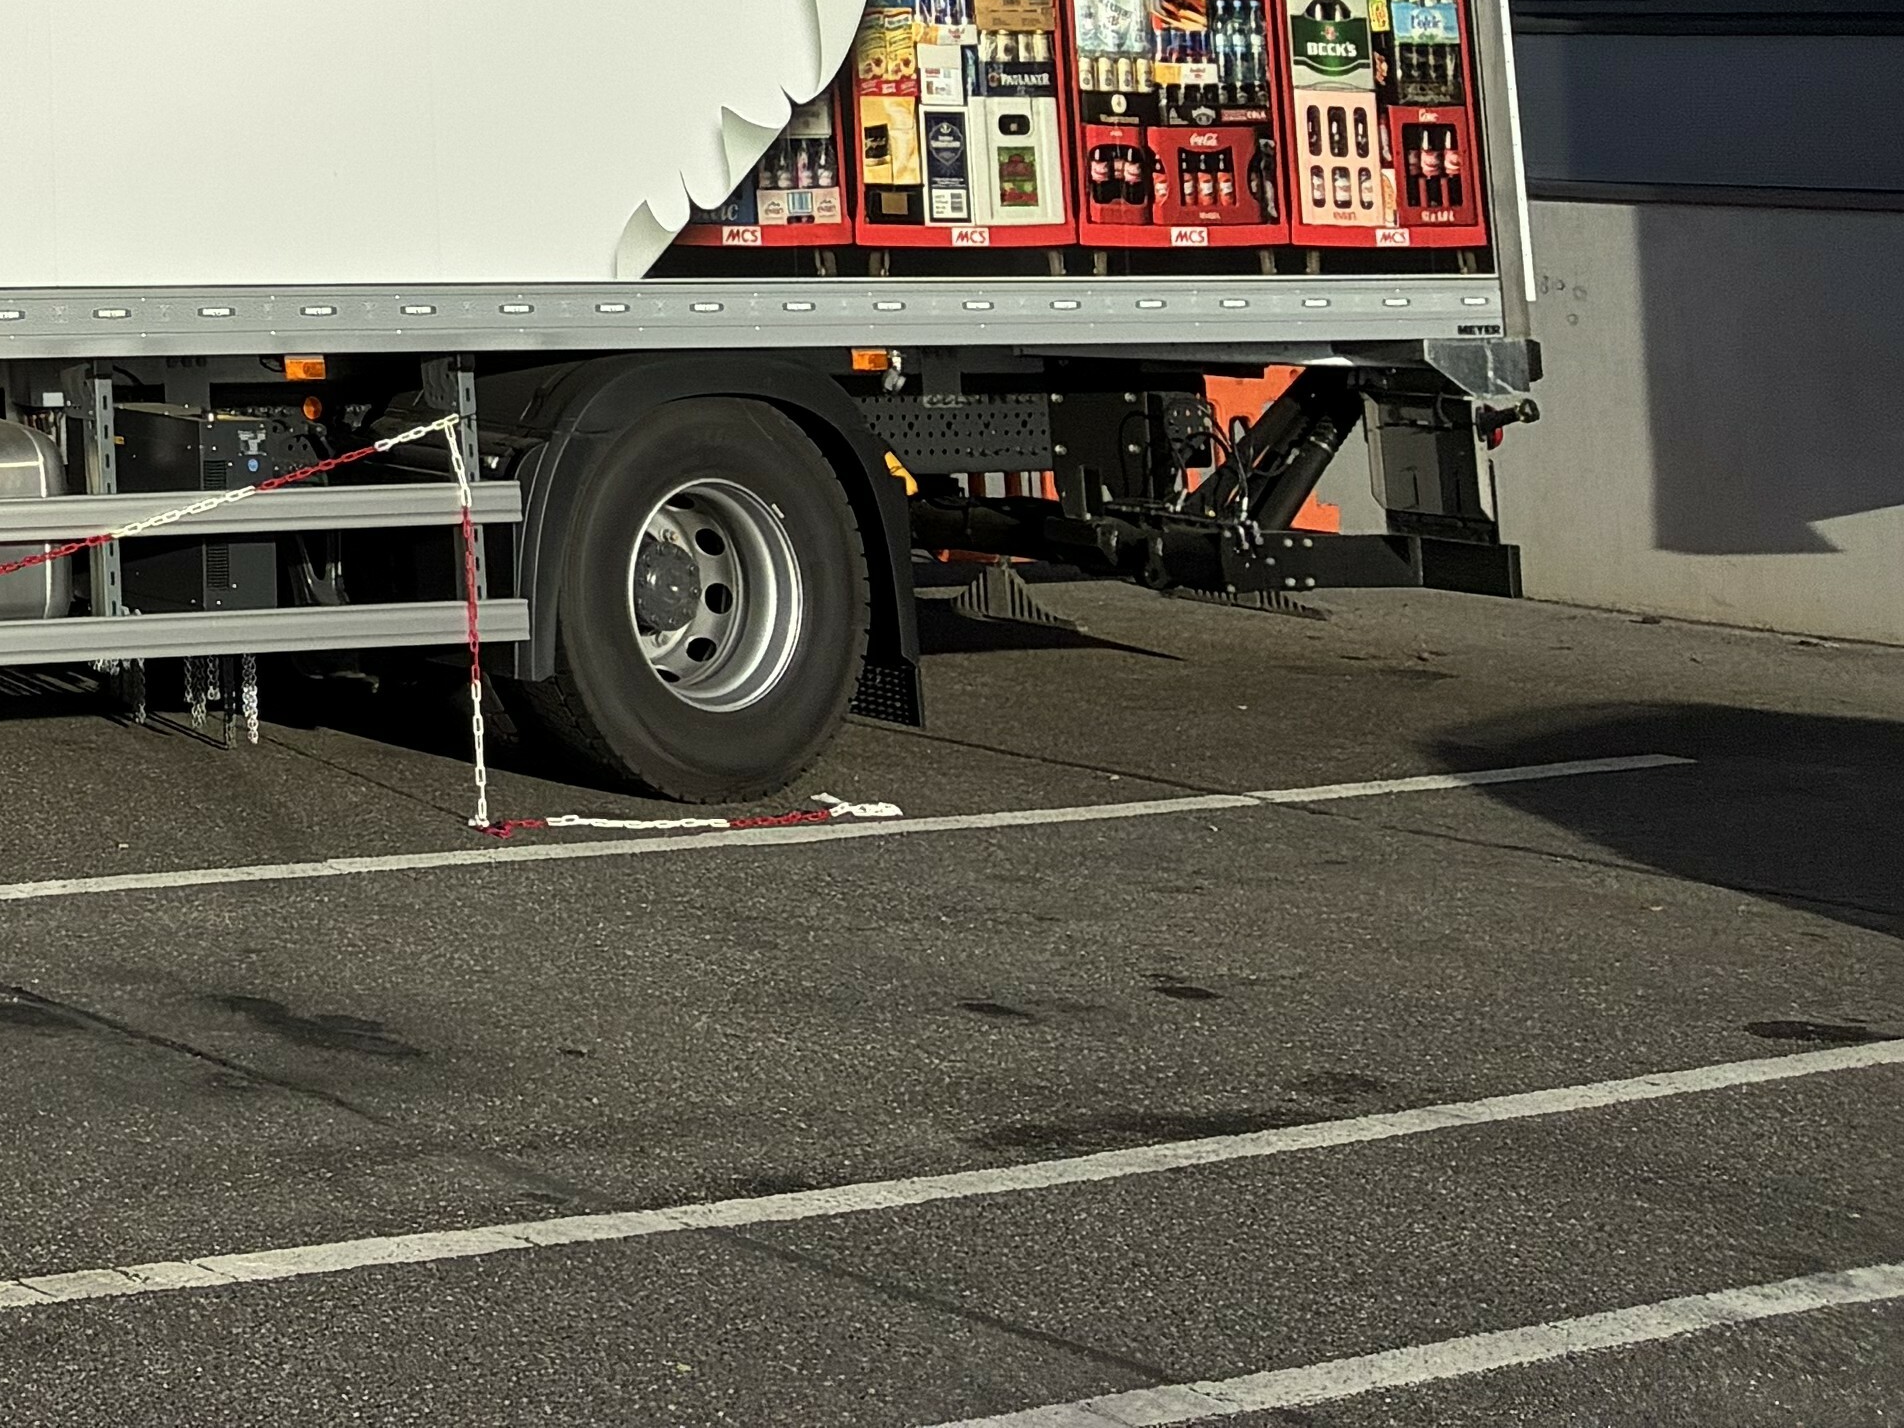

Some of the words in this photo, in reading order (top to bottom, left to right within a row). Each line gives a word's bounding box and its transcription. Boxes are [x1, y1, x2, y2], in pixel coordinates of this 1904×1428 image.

[725, 228, 759, 243] MCS
[955, 229, 987, 244] MCS
[1174, 229, 1206, 243] MCS
[1379, 231, 1407, 244] MCS
[1457, 324, 1501, 336] MEYER
